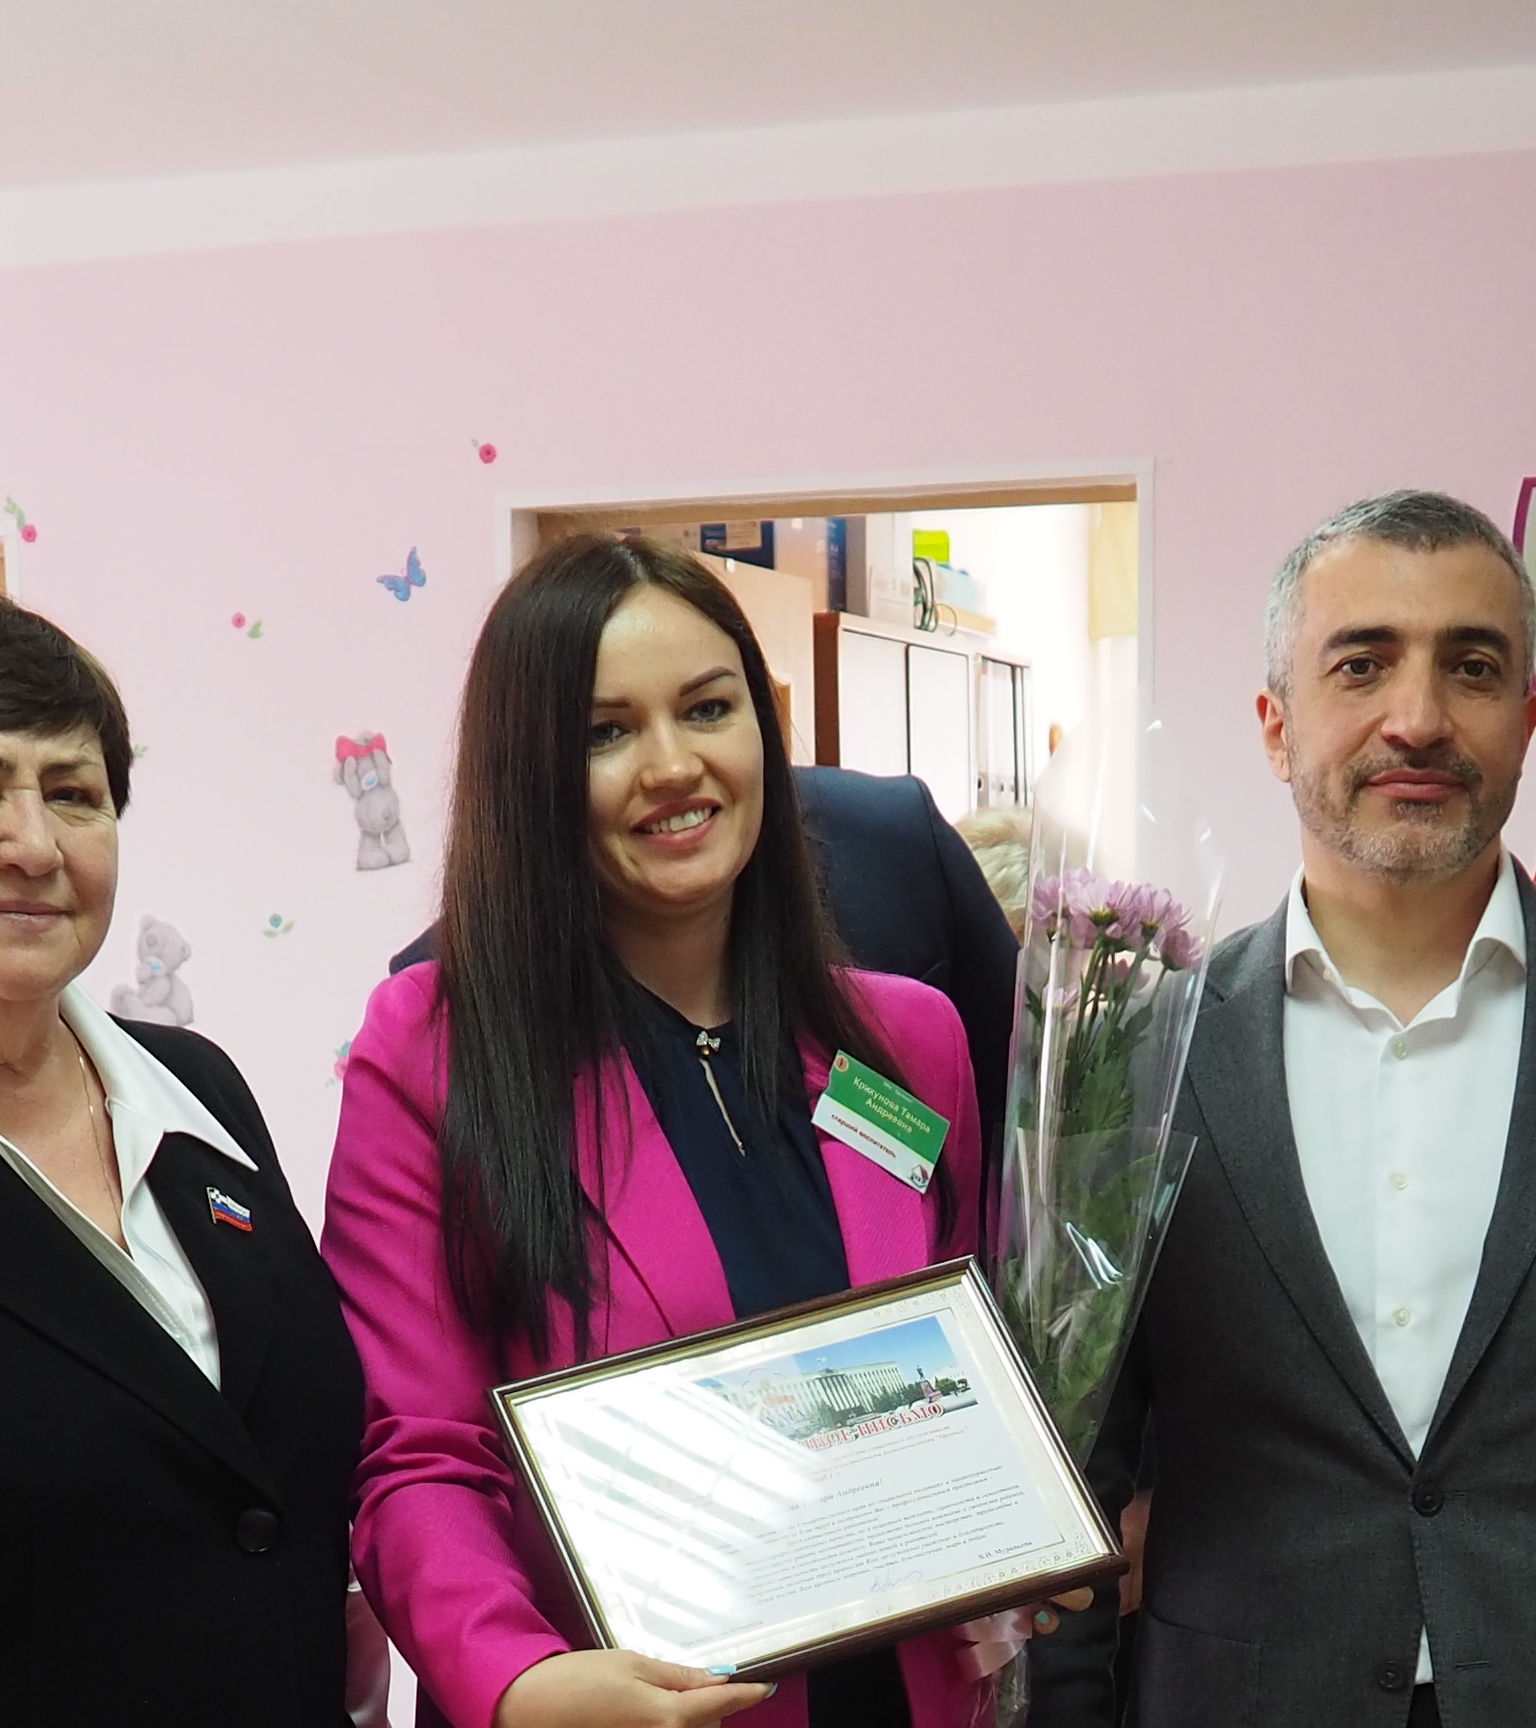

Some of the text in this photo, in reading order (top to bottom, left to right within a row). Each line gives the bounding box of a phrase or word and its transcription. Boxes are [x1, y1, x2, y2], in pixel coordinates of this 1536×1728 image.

[865, 1098, 912, 1133] Андреевна
[901, 1106, 931, 1133] Тамара
[859, 1131, 896, 1158] воспитатель
[856, 1401, 944, 1438] ПИСЬМО
